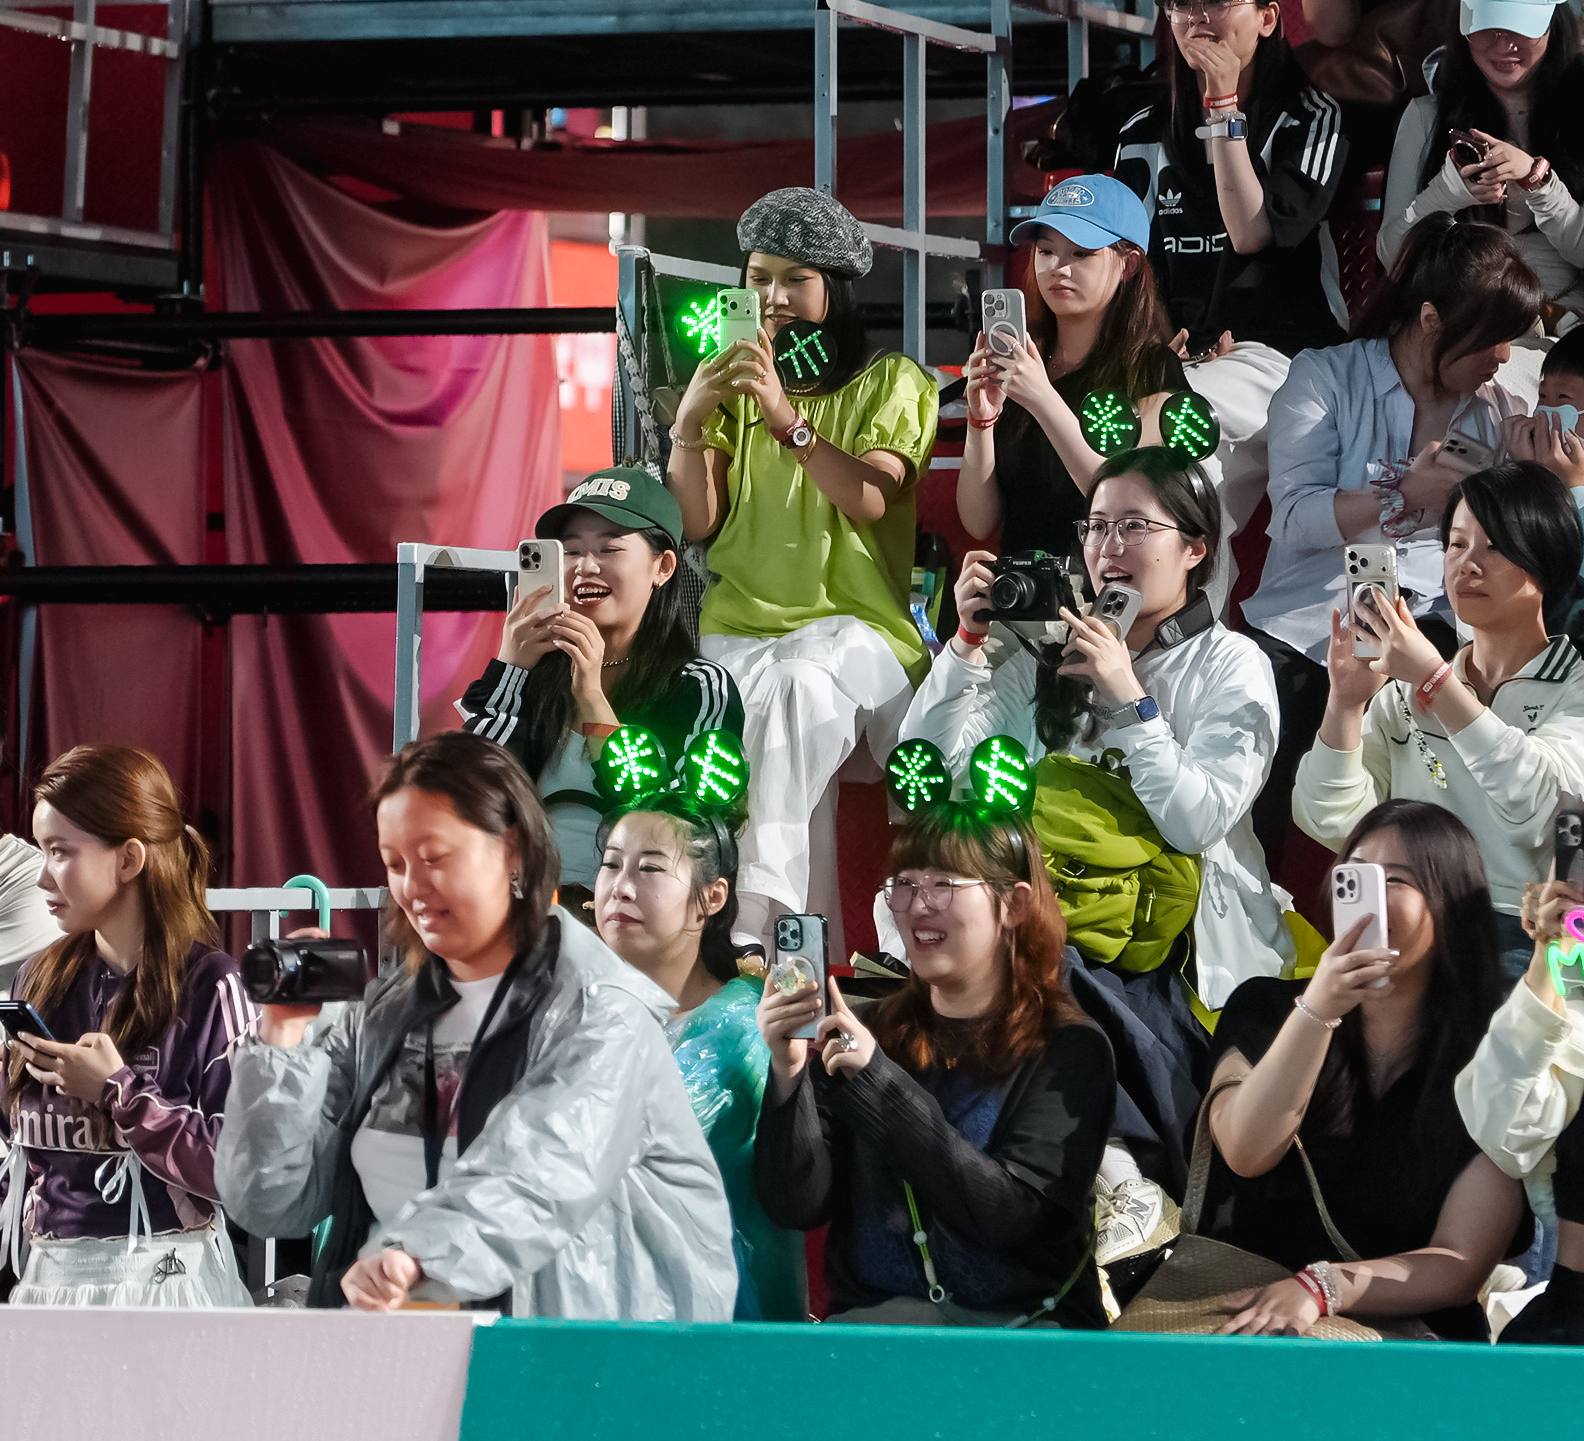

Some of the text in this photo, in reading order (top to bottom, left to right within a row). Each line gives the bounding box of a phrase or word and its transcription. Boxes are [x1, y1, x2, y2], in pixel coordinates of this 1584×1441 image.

[1158, 207, 1183, 216] adidas
[1082, 392, 1212, 458] 米 卡
[607, 726, 743, 802] 米 卡
[888, 737, 1028, 809] 米 卡
